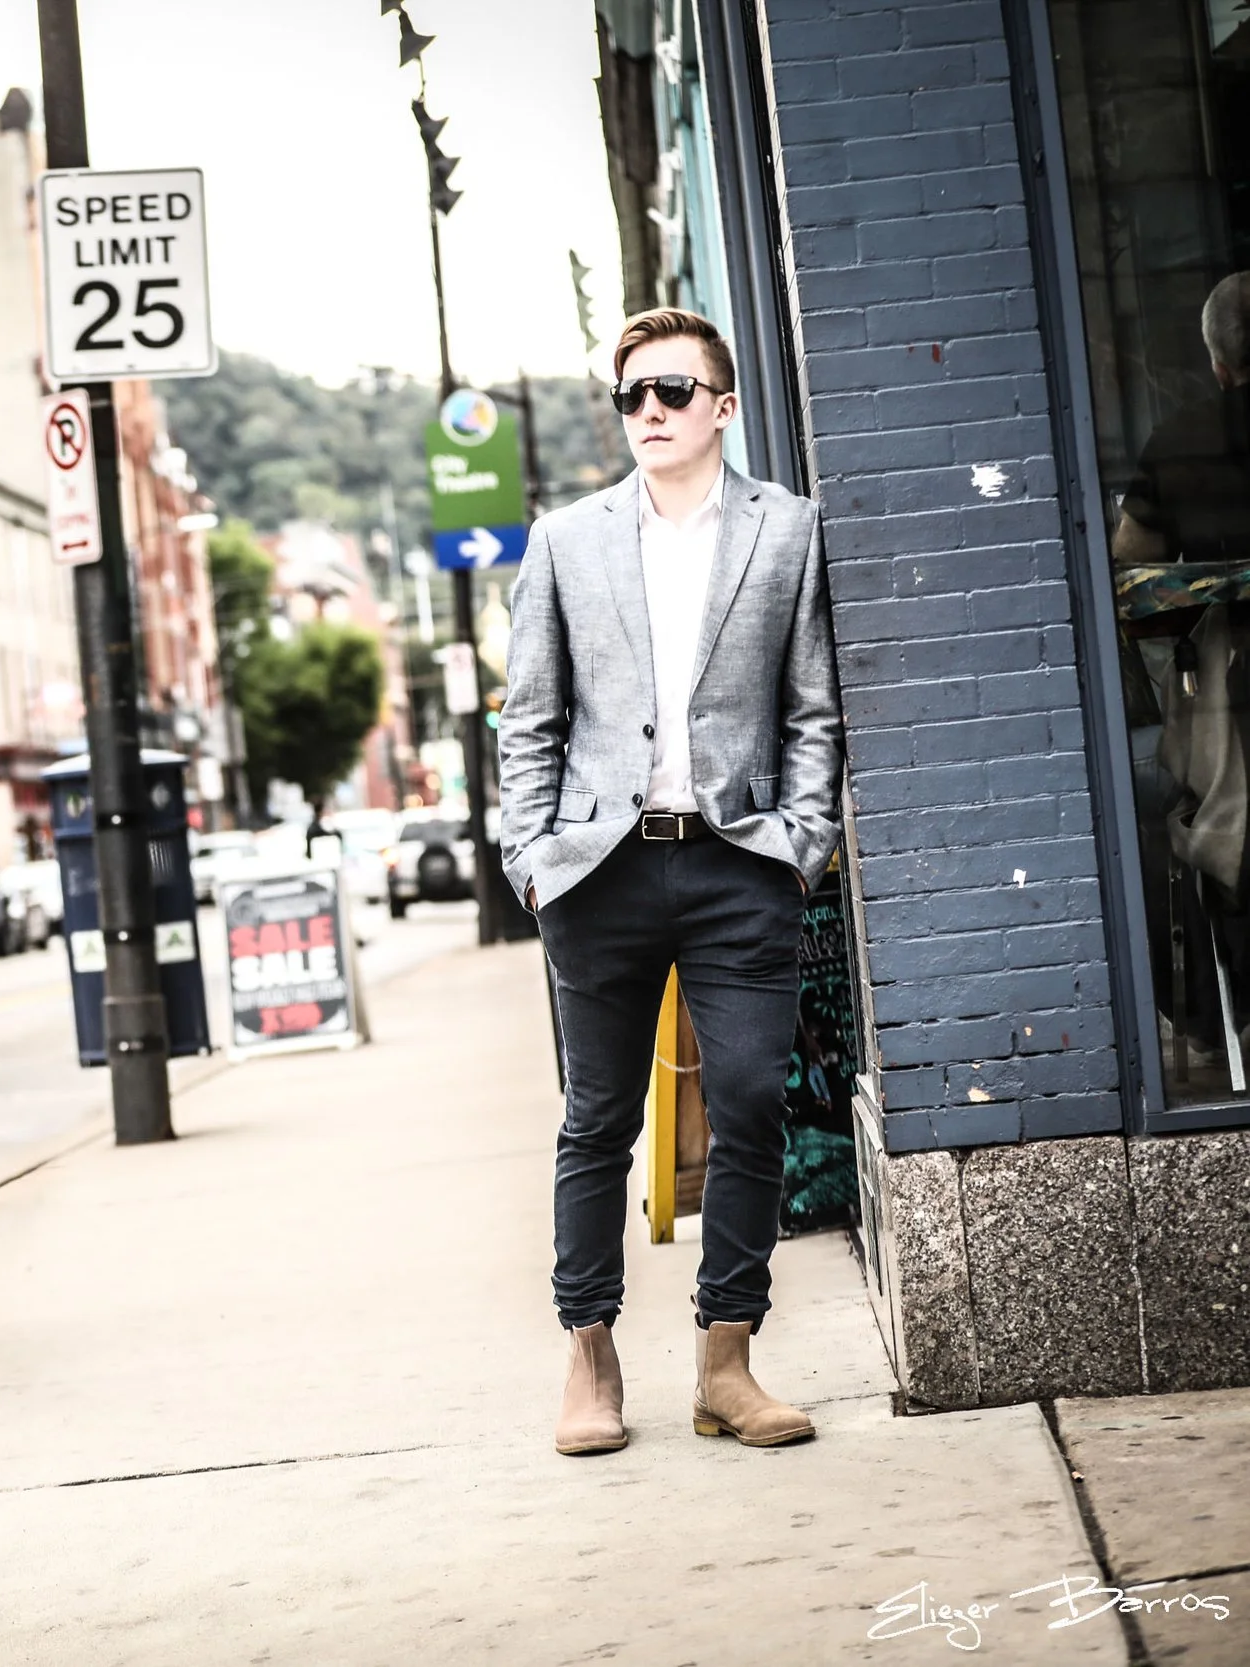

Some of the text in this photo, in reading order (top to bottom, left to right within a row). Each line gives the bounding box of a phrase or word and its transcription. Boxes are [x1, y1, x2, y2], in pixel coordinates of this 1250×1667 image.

[56, 192, 191, 226] SPEED
[75, 236, 176, 267] LIMIT
[73, 278, 183, 351] 25
[230, 916, 334, 957] SALE
[232, 946, 338, 992] SALE
